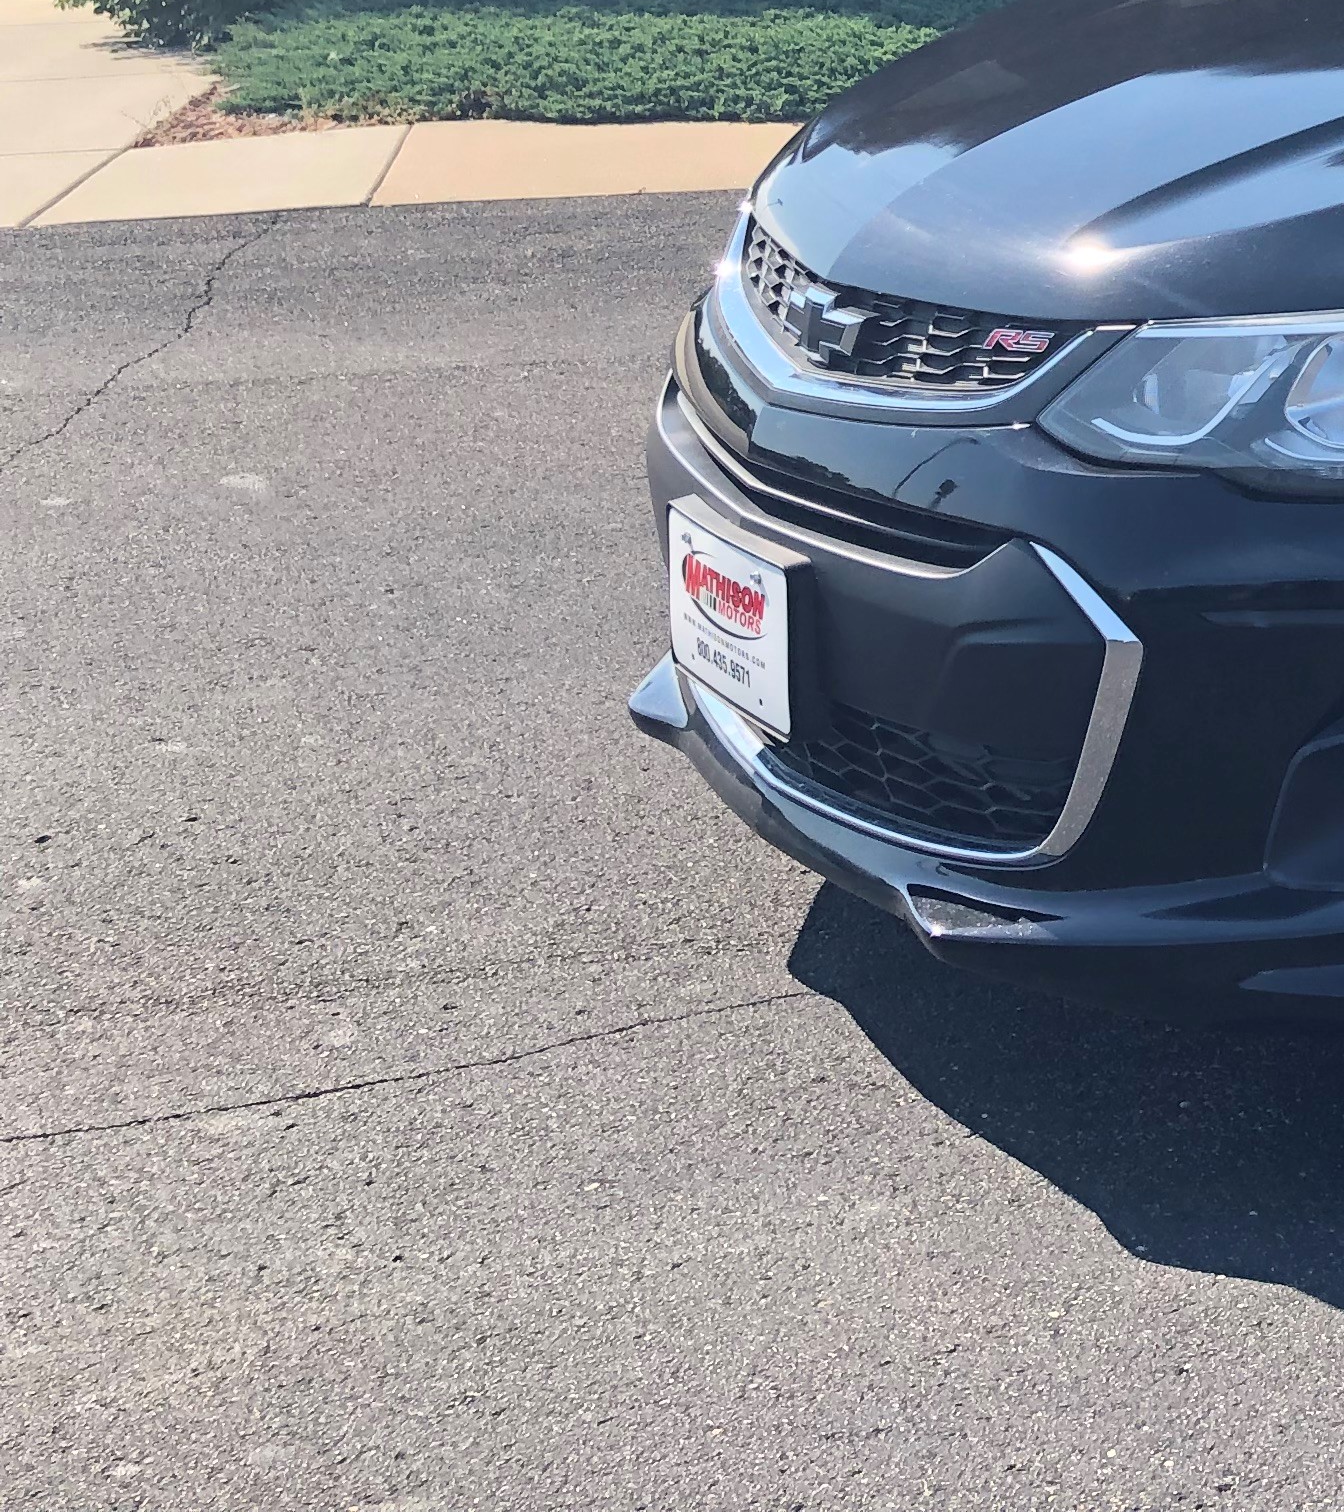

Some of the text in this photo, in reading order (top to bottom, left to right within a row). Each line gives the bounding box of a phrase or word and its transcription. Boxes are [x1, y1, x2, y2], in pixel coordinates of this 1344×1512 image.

[982, 328, 1055, 353] RS
[685, 552, 766, 621] MATHISON
[717, 599, 762, 636] MOTORS
